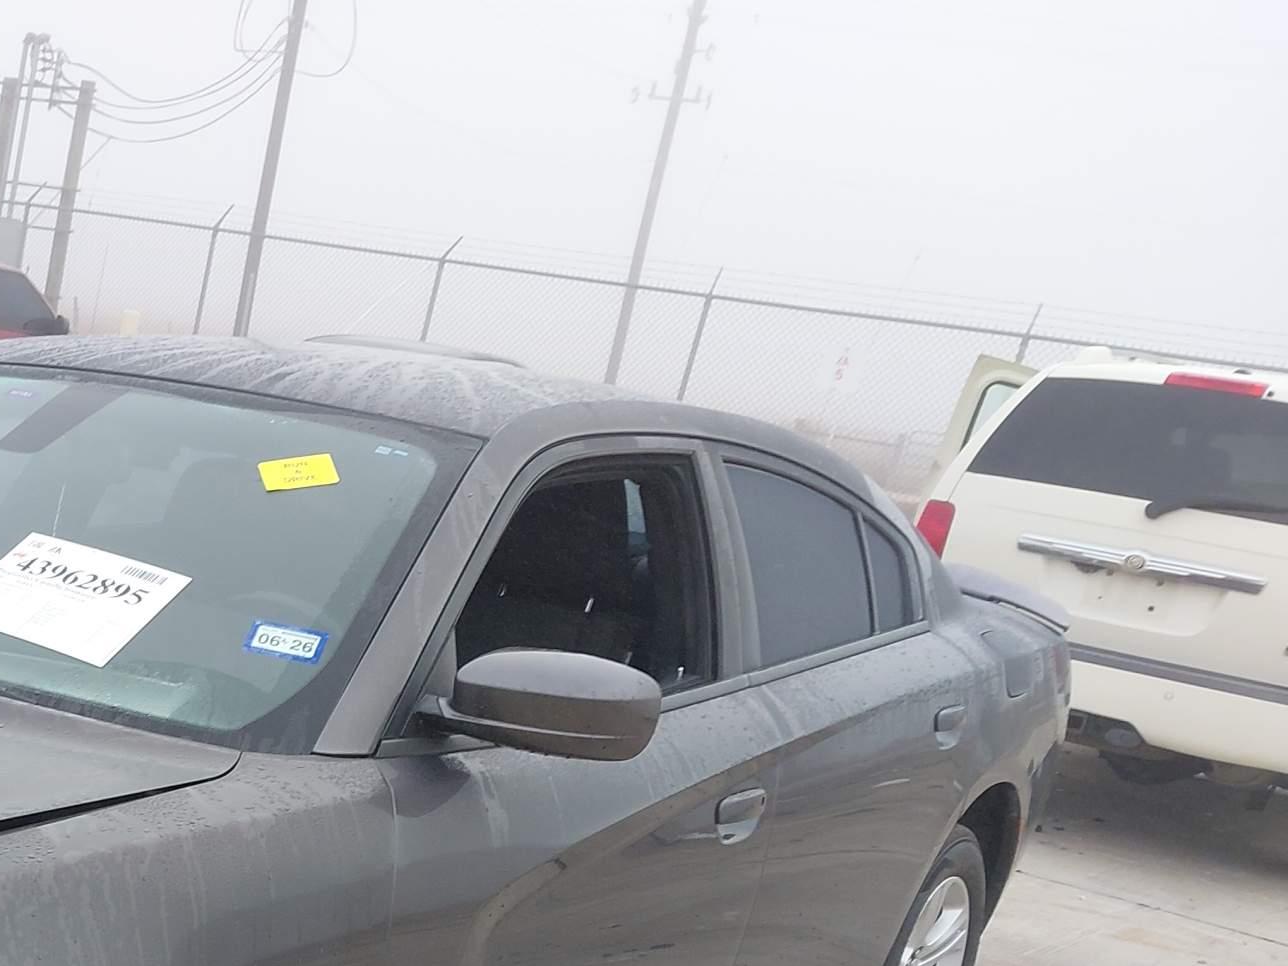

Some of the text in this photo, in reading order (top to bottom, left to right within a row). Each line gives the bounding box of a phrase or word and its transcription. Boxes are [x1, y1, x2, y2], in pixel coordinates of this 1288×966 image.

[16, 556, 151, 607] 43962895
[258, 632, 282, 647] 06
[289, 639, 314, 653] 26
